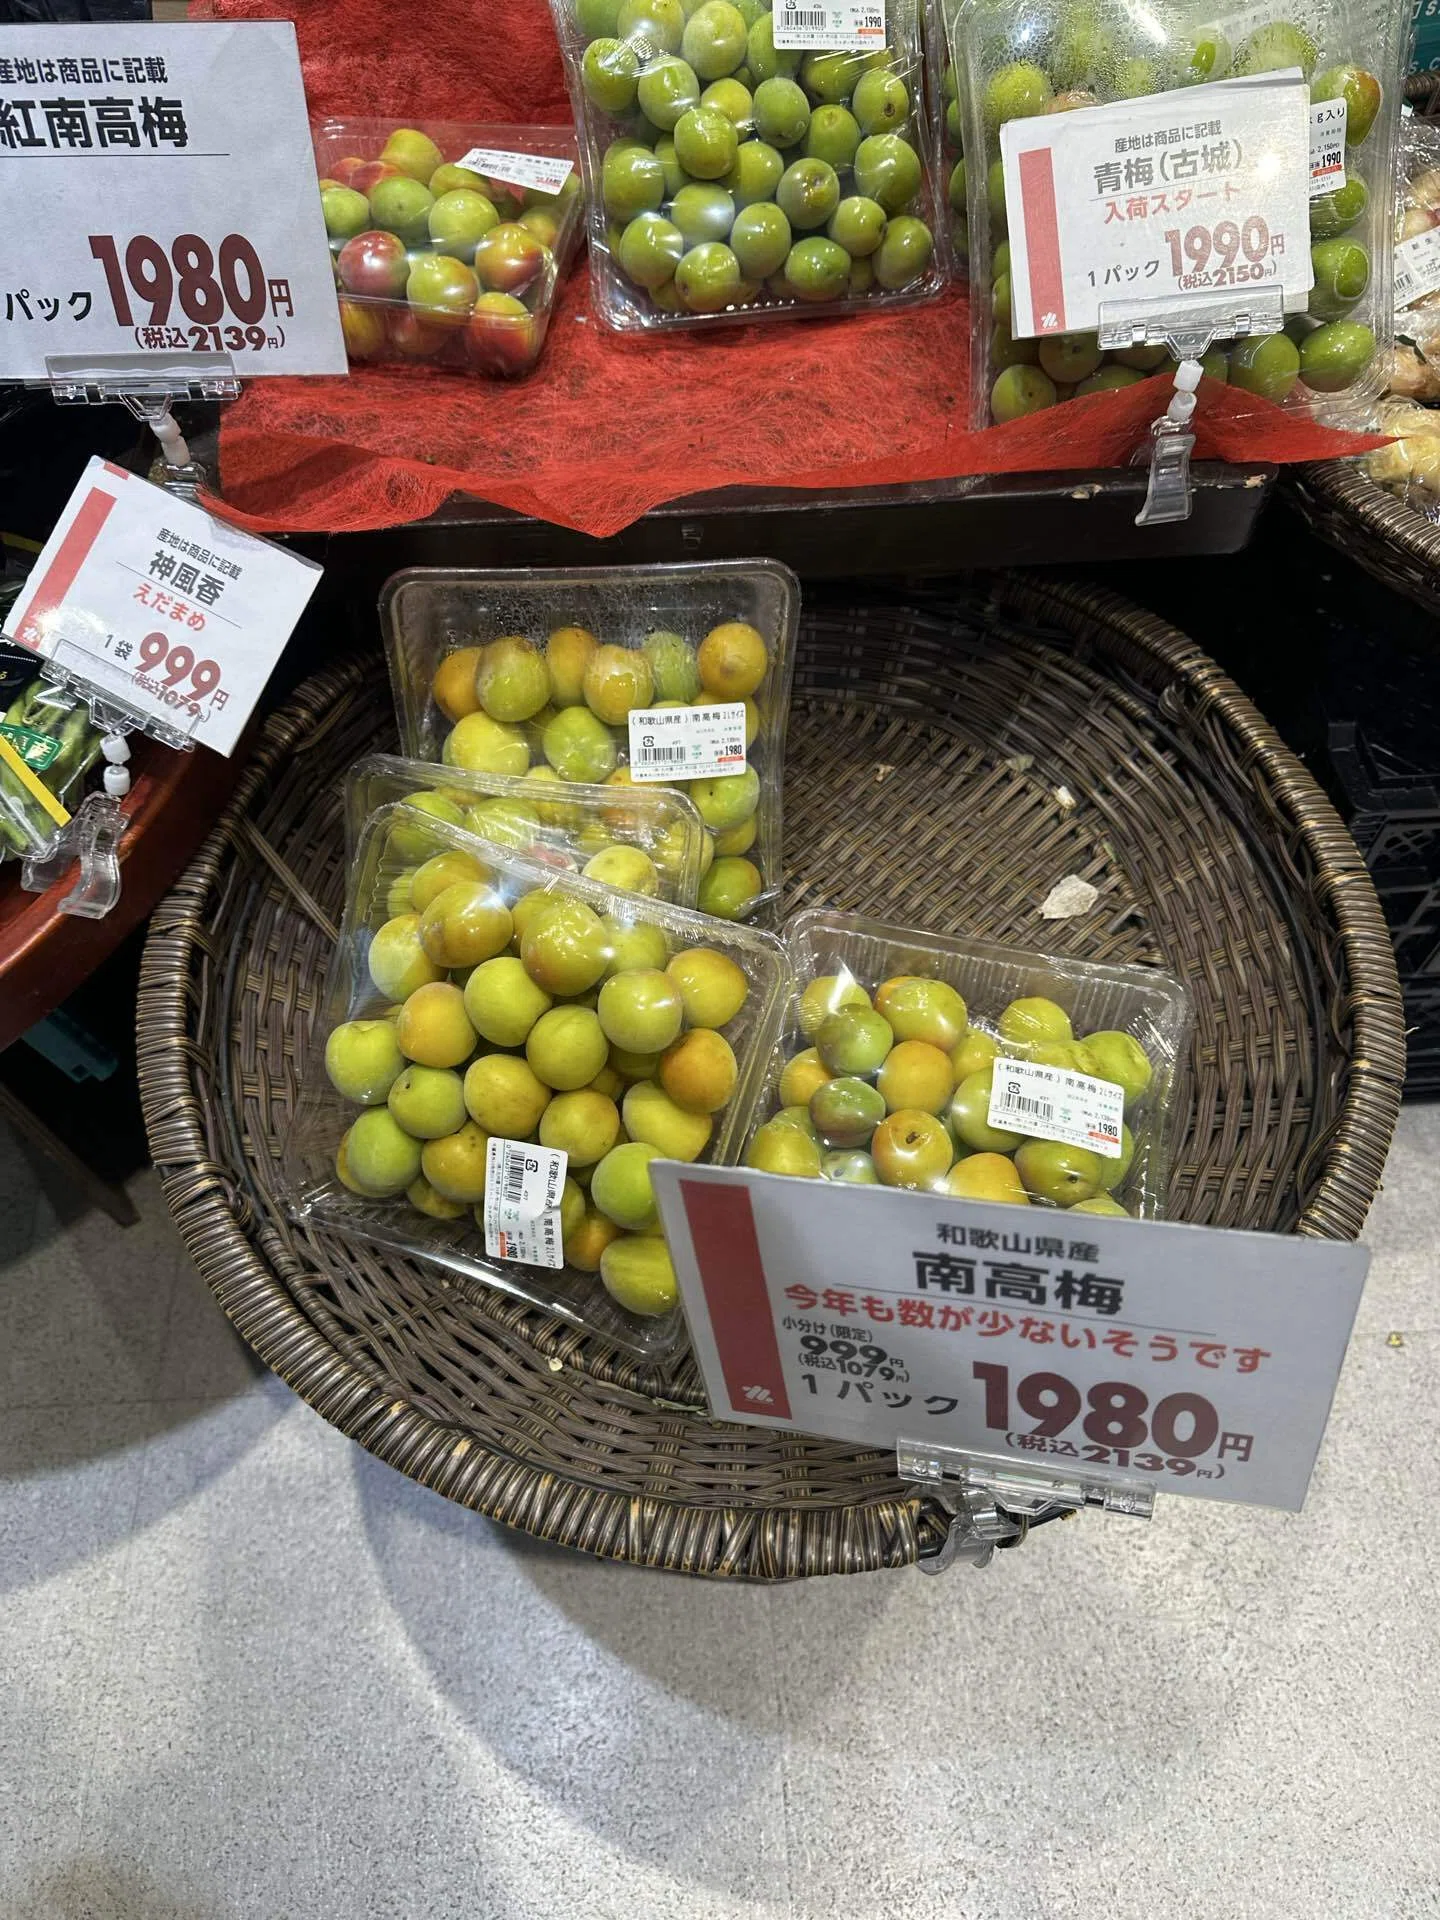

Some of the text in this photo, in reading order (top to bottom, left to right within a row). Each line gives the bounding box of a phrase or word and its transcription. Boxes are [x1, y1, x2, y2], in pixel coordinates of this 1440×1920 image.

[865, 16, 881, 27] 1990
[0, 57, 169, 84] 産地は商品に記載
[0, 97, 188, 149] 紅南高梅
[1114, 120, 1222, 153] 産地は商品に記載
[1322, 151, 1341, 168] 1990
[1104, 181, 1240, 224] 入荷スタート
[1177, 260, 1277, 291] (税込2150円)
[134, 325, 286, 351] (税込2139円)
[156, 527, 243, 580] 産地は商品に記載
[148, 549, 226, 606] 神風香
[133, 583, 206, 631] えだまめ
[725, 744, 742, 756] 1980
[1099, 1121, 1119, 1137] 1980
[936, 1222, 1100, 1264] 和歌山県産
[912, 1250, 1125, 1316] 南高梅
[782, 1315, 873, 1343] 小分け(限定)
[783, 1283, 1272, 1374] 今年も数が少ないそうです
[797, 1352, 910, 1384] (税込1079円)
[800, 1335, 905, 1369] 999円
[1004, 1431, 1225, 1479] (税込2139円)
